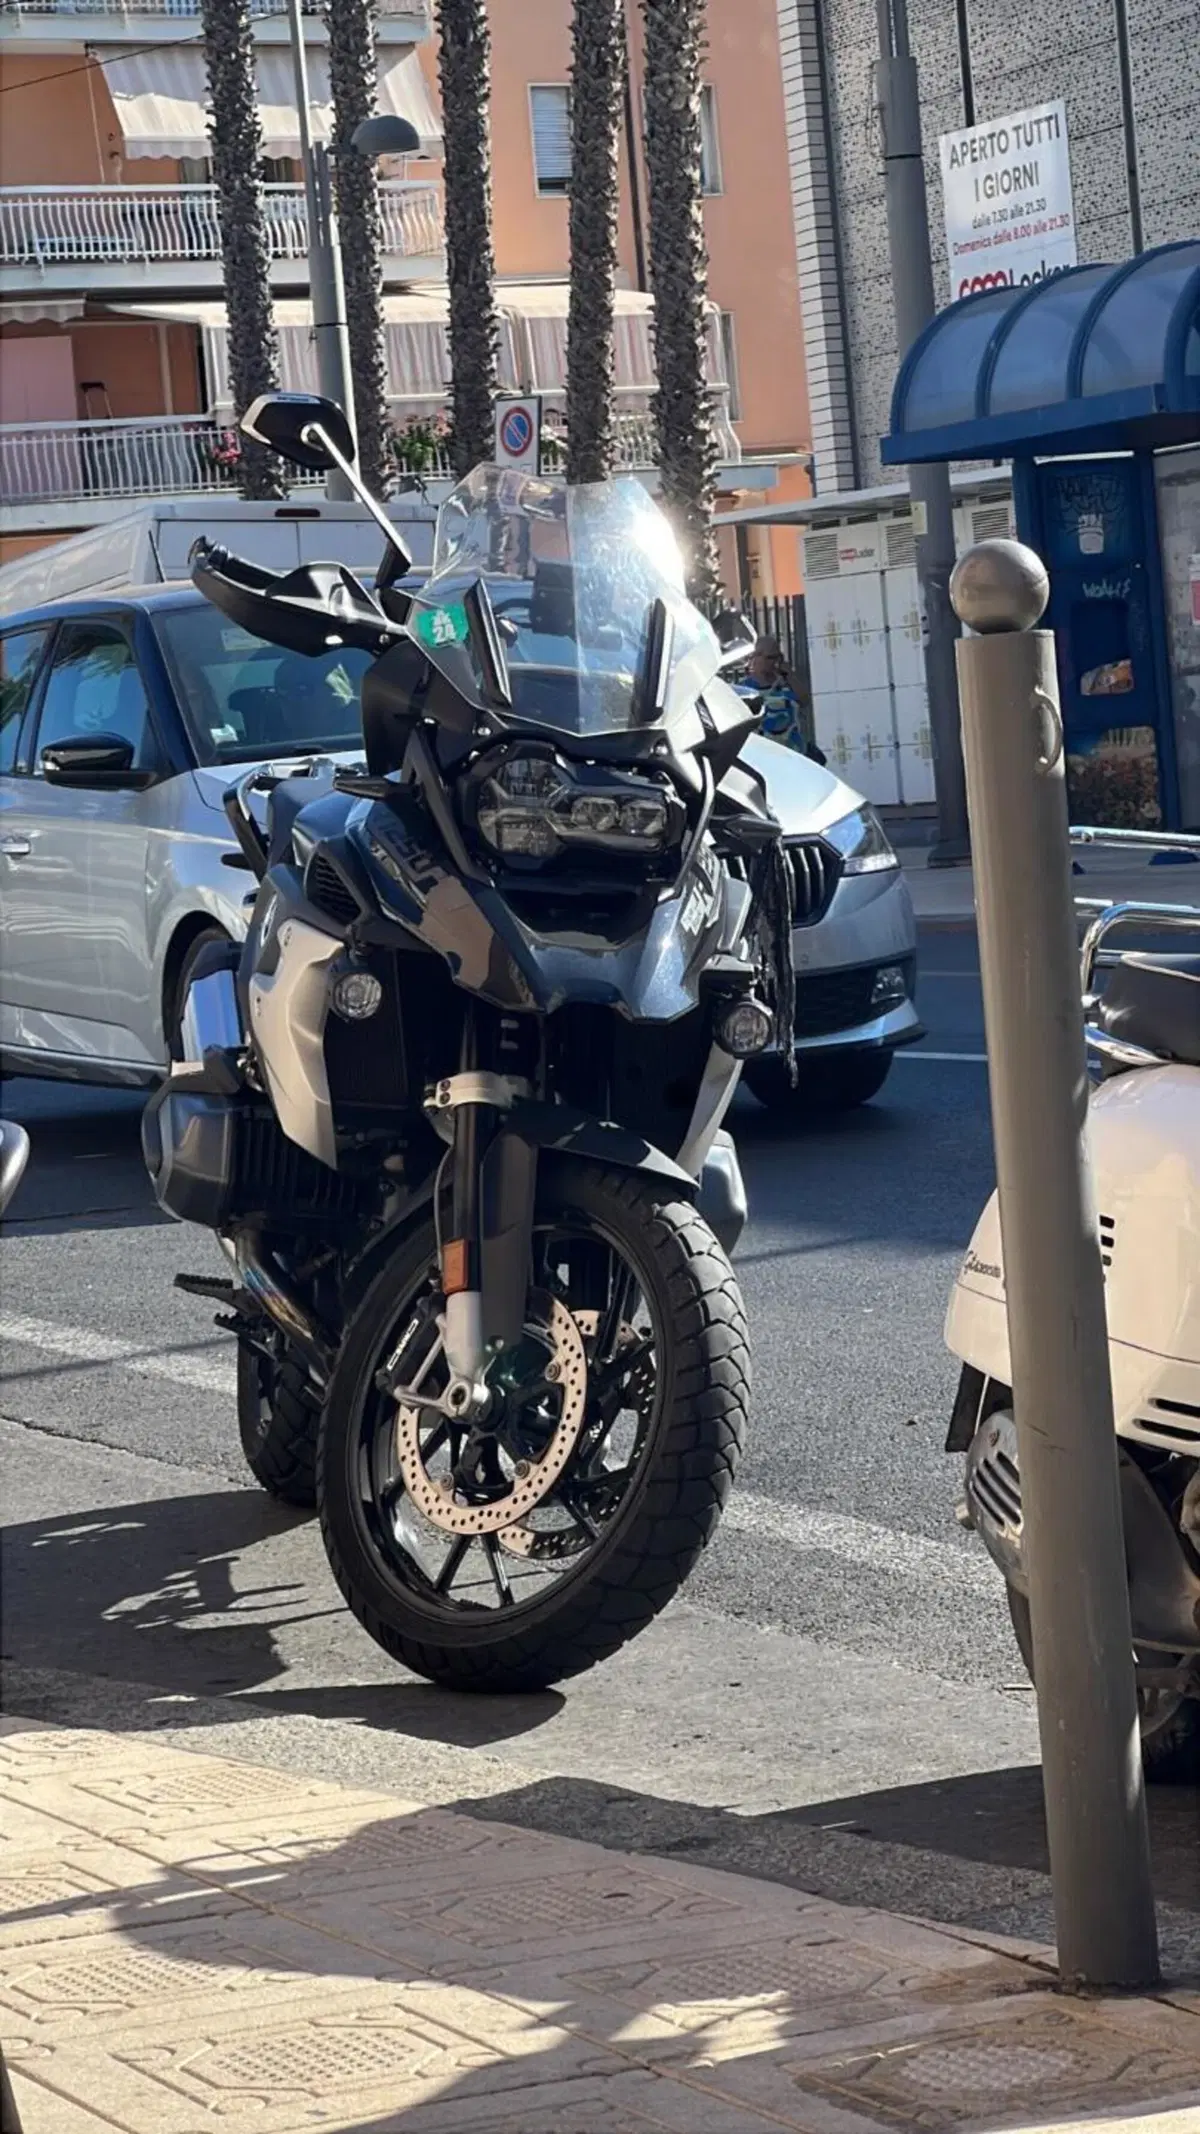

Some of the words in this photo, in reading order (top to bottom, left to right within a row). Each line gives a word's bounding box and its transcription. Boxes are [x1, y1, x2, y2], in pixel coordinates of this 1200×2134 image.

[949, 128, 1009, 170] APERTO
[1012, 112, 1060, 150] TUTTI
[974, 177, 980, 202] I
[983, 160, 1040, 200] GIORNI
[1010, 203, 1024, 220] alle
[1025, 197, 1047, 216] 21.30
[953, 236, 992, 256] Domenica
